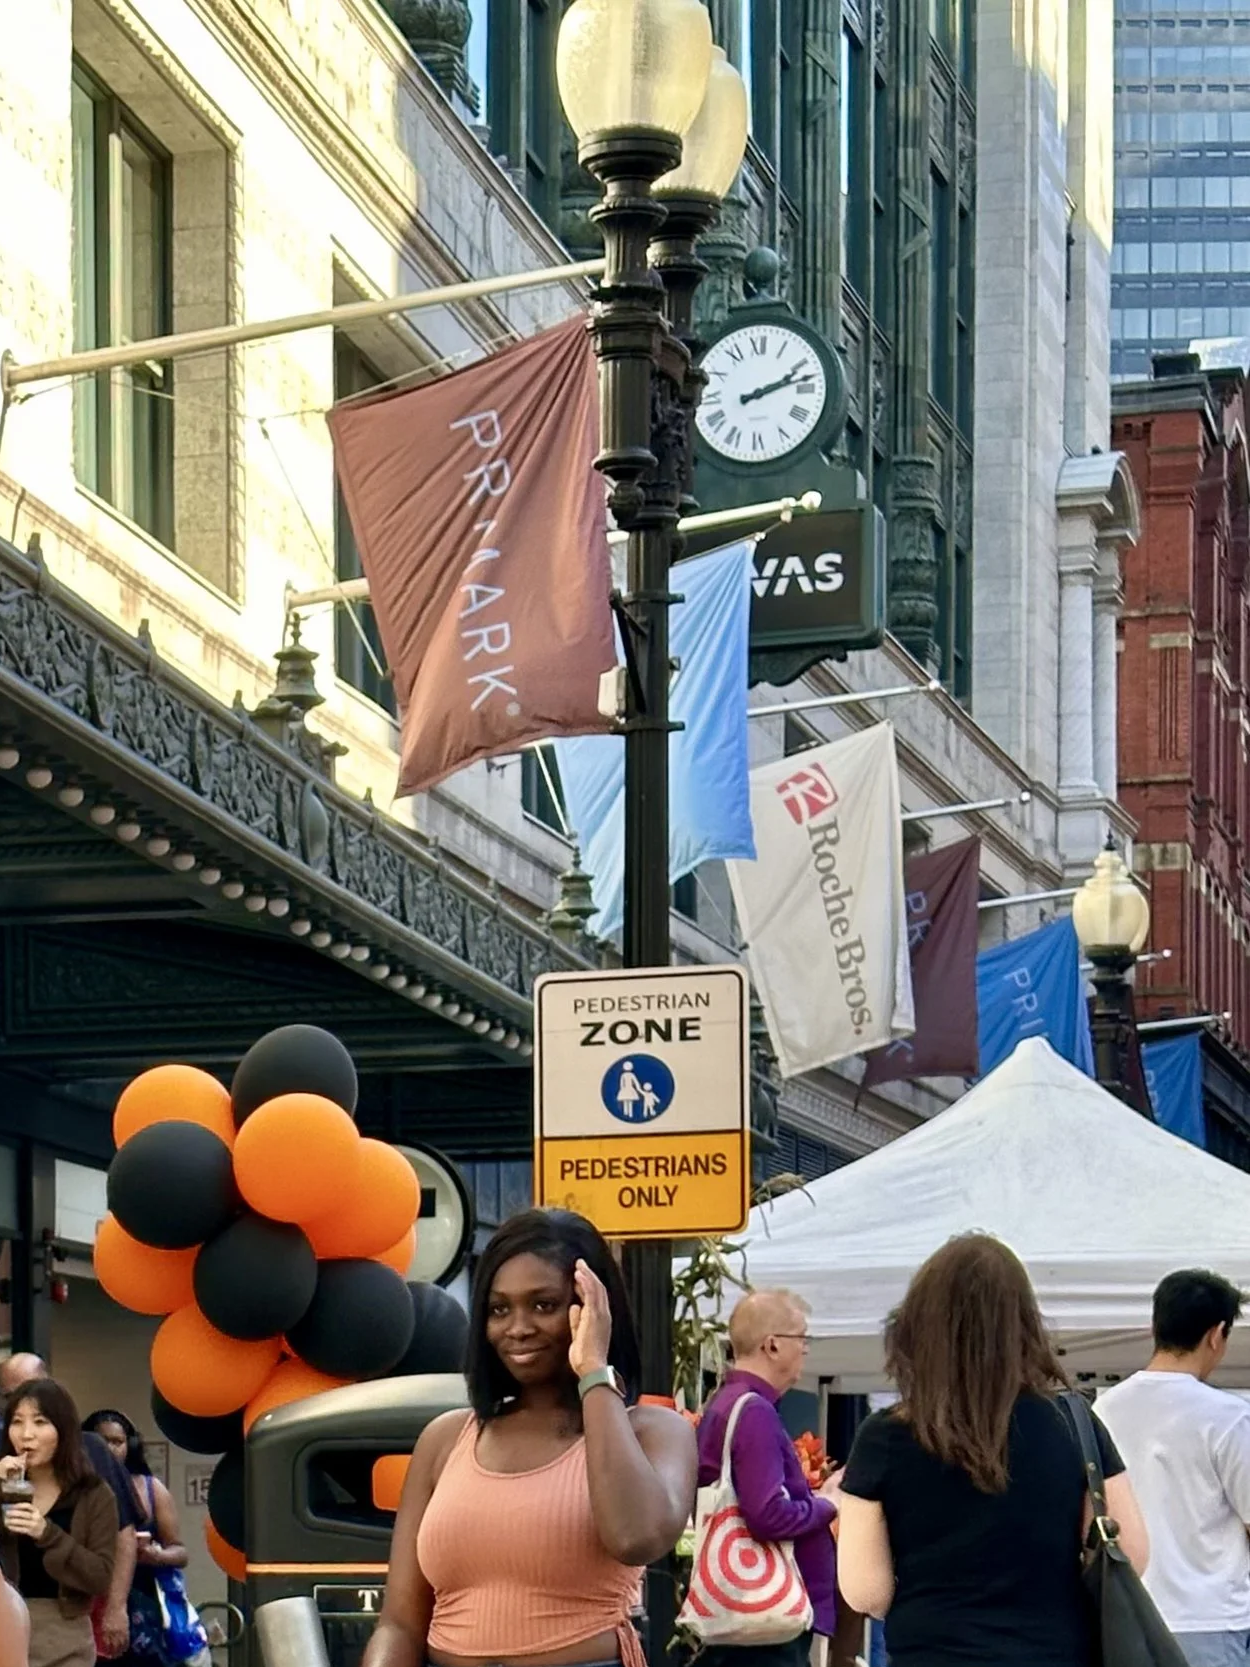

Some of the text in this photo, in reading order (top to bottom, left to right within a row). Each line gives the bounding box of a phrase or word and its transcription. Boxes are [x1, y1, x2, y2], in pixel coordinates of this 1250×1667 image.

[751, 552, 844, 598] VAS
[807, 815, 872, 1036] Roche Bros.
[573, 992, 711, 1015] PEDESTRIAN
[1003, 966, 1045, 1033] PRI
[579, 1016, 702, 1047] ZONE
[559, 1152, 728, 1181] PEDESTRIANS
[617, 1184, 679, 1209] ONLY
